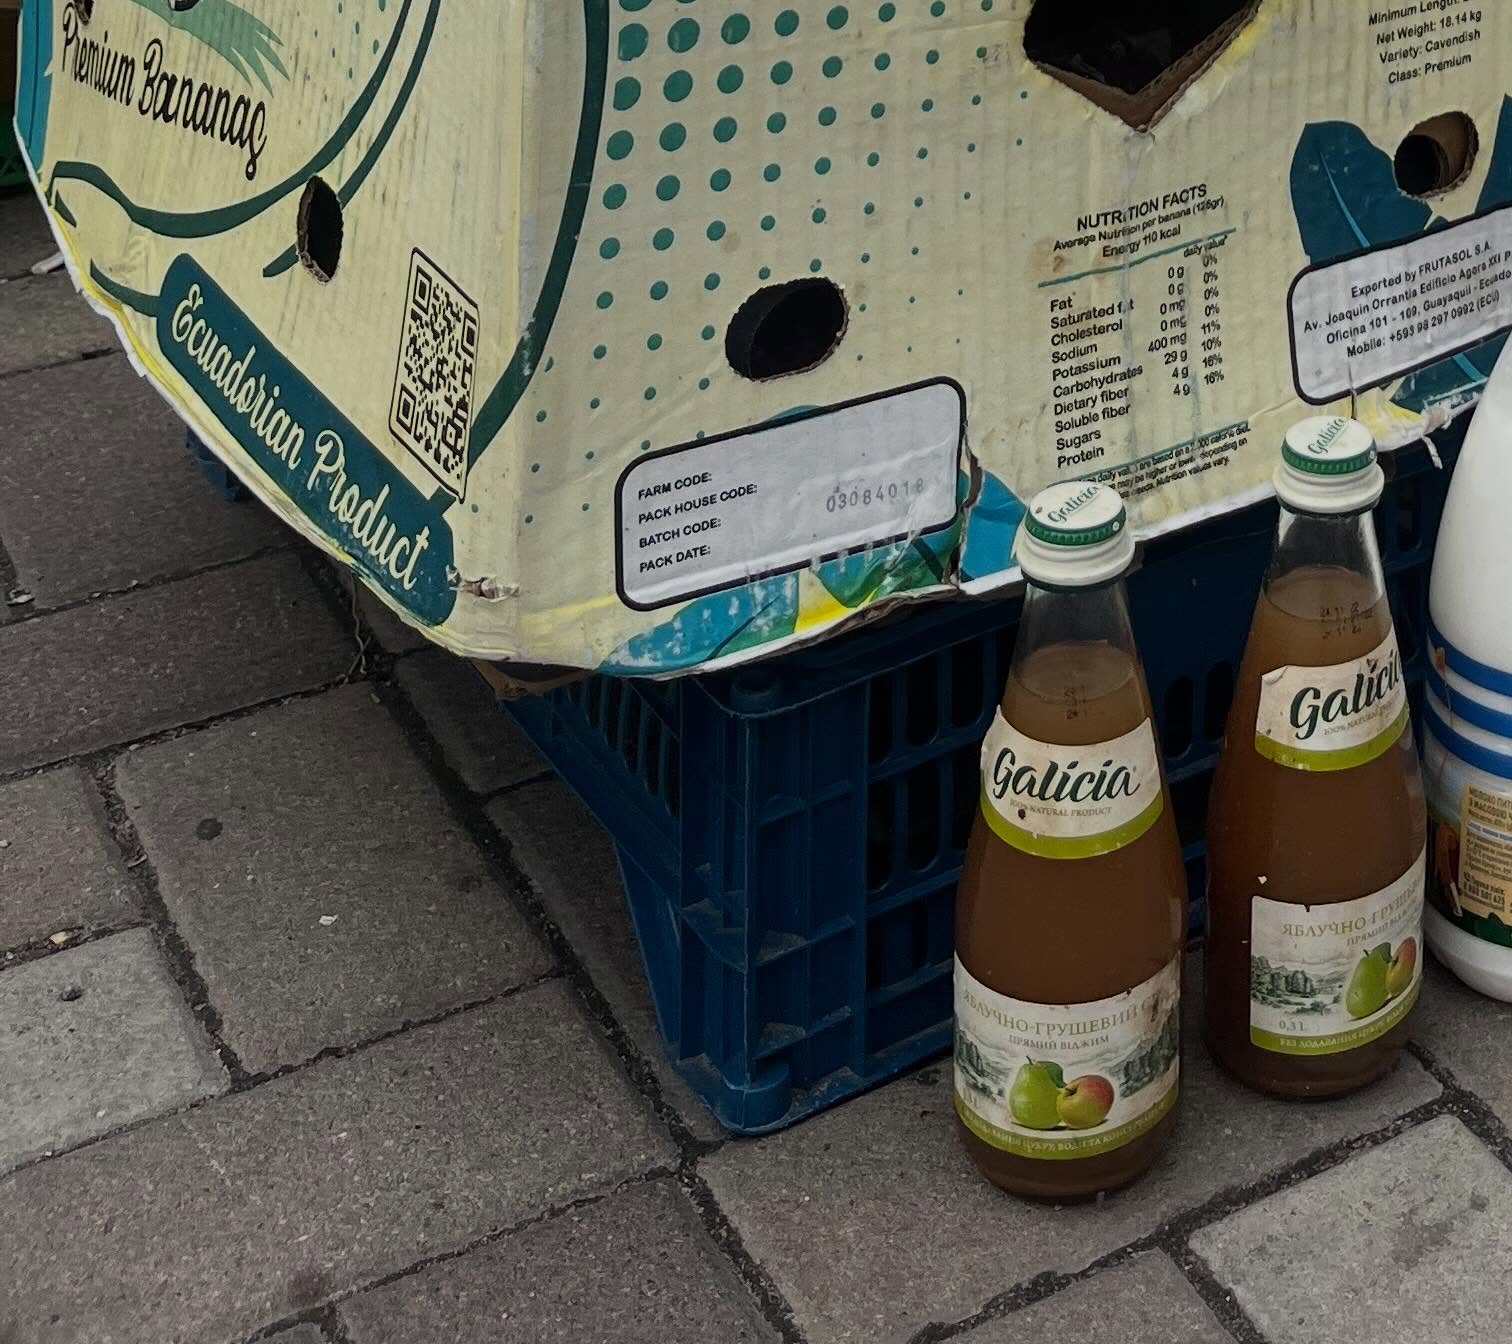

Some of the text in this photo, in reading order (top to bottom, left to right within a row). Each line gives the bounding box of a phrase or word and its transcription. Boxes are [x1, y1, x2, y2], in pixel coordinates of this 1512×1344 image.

[1368, 4, 1417, 27] Minimum
[1376, 11, 1468, 46] Net Weight: 18.14
[1379, 29, 1481, 65] Variety: Cavendish
[1388, 53, 1472, 85] Class: Premium
[61, 1, 268, 180] Premium Bananas
[1162, 183, 1208, 209] FACTS
[1053, 232, 1096, 253] Average
[1102, 224, 1182, 259] Energy kcal
[1351, 240, 1492, 298] Exported FRUTASOL S.A.
[1050, 295, 1073, 313] Fat
[1326, 273, 1456, 326] Joaquin Orrantia Edificio
[1326, 323, 1367, 345] Oficina
[1369, 313, 1389, 329] 101
[1423, 285, 1472, 310] Guayaquil
[1051, 304, 1115, 330] Saturated
[1051, 319, 1123, 347] Cholesterol
[1347, 337, 1386, 358] Mobile:
[1389, 324, 1415, 342] +593
[1051, 343, 1099, 364] Sodium
[1052, 356, 1121, 381] Potassium
[1053, 363, 1143, 398] Carbohydrates
[1054, 386, 1130, 418] Dietary fiber
[1055, 403, 1131, 434] Soluble fiber
[172, 283, 431, 592] Ecuadorian Product
[1056, 429, 1102, 451] Sugars
[1057, 446, 1105, 468] Protein
[638, 471, 712, 500] FARM CODE:
[638, 483, 758, 525] PACK HOUSE CODE:
[639, 517, 722, 549] BATCH CODE:
[639, 545, 711, 573] PACK DATE:
[993, 747, 1142, 803] Galicia
[1029, 804, 1113, 818] NATURAL PRODUCT
[1007, 1033, 1110, 1052] ПРЯМИЙ ВІДЖИМ
